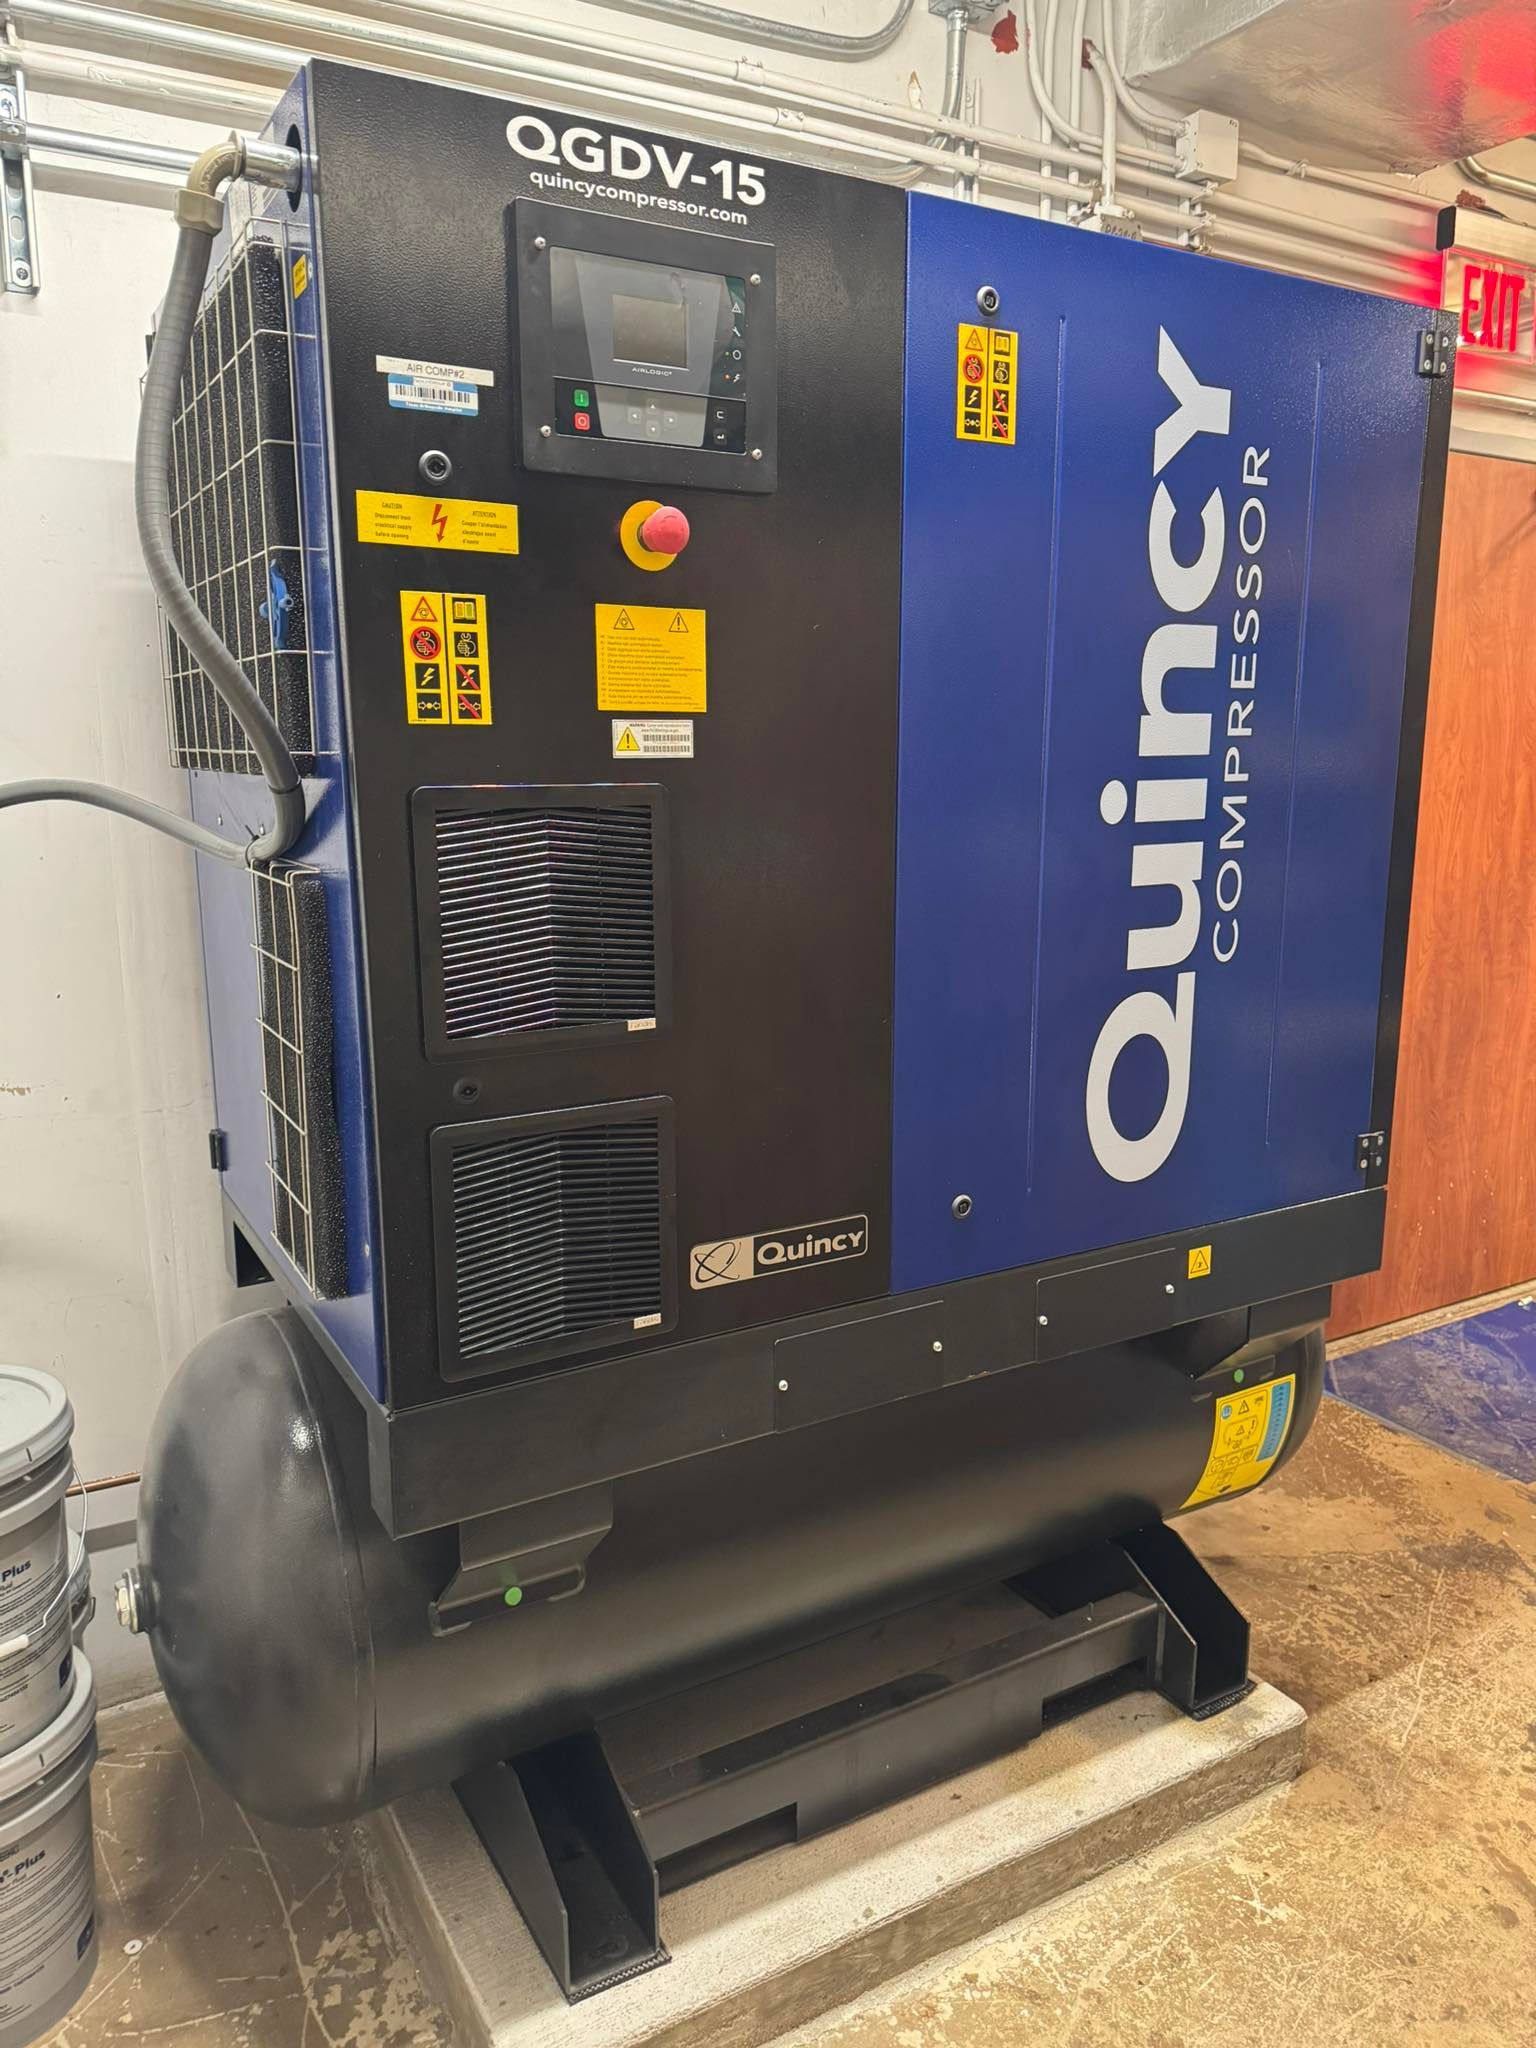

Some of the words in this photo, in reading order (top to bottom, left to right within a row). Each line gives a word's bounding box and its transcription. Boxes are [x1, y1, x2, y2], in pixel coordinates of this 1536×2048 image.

[506, 115, 766, 206] QGDV-15
[530, 171, 748, 225] quincycompressor.com
[1461, 265, 1525, 352] EXIT
[407, 363, 423, 373] AIR
[425, 366, 465, 380] COMP#2
[1213, 446, 1270, 962] COMPRESSOR
[2, 1560, 32, 1582] Plus
